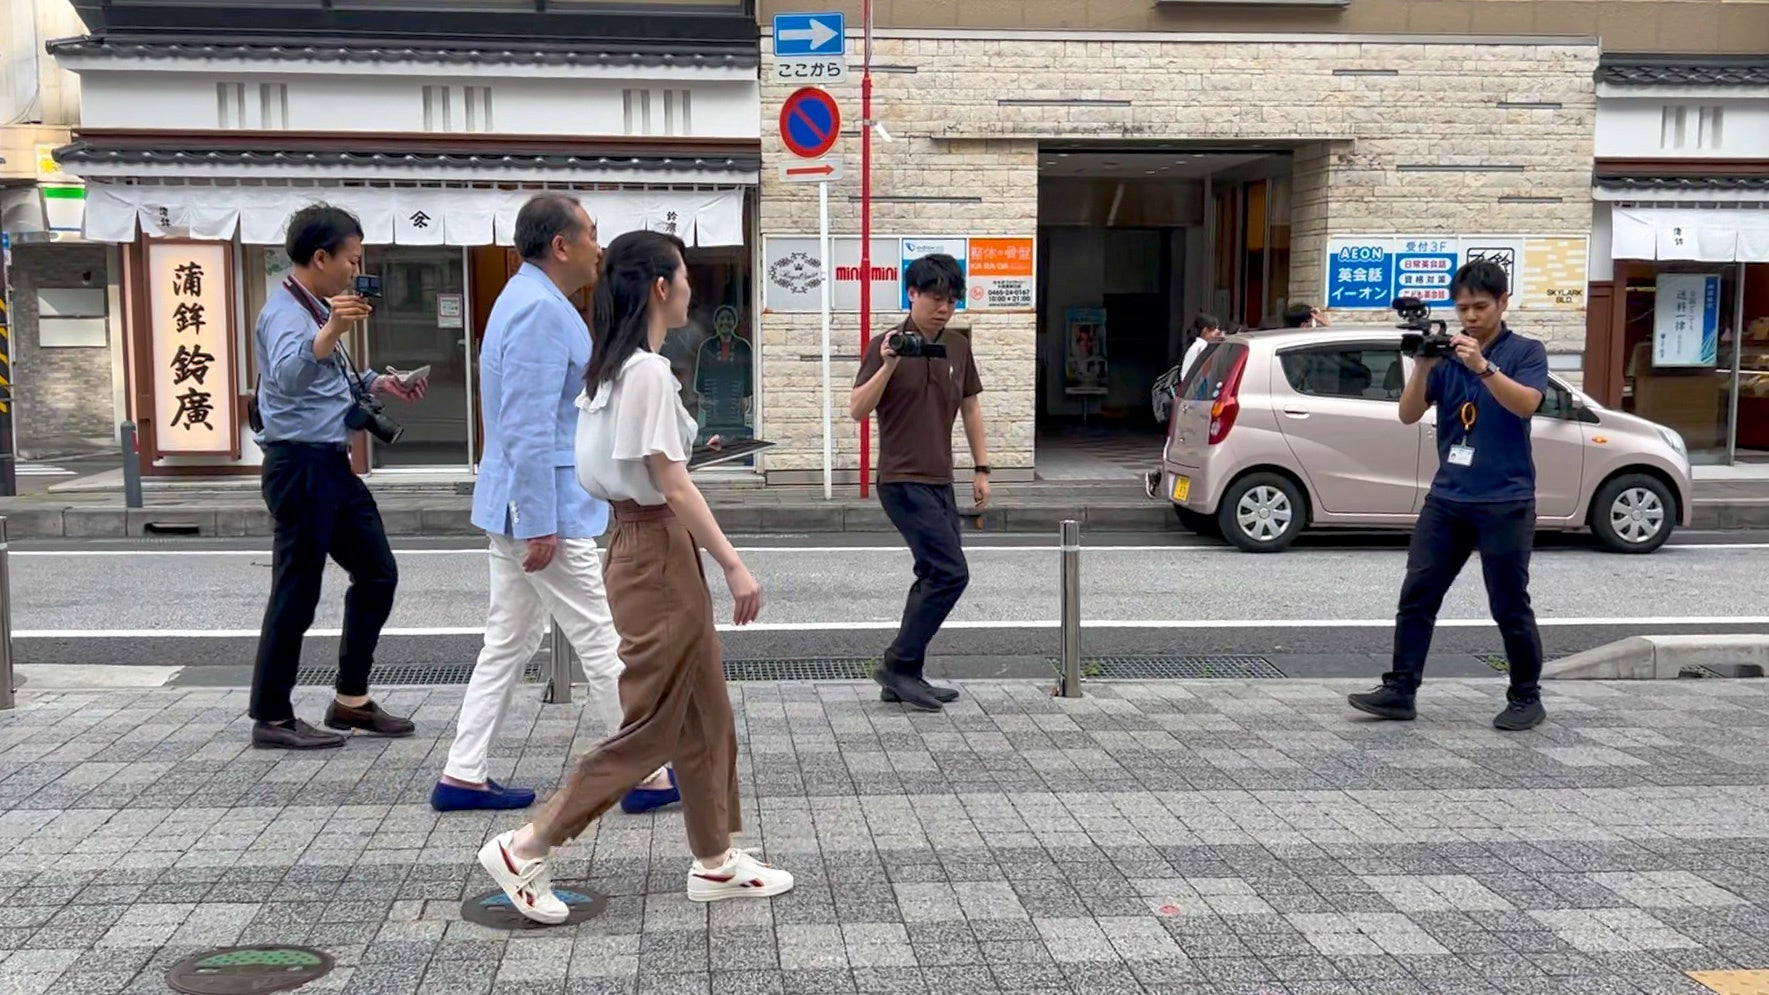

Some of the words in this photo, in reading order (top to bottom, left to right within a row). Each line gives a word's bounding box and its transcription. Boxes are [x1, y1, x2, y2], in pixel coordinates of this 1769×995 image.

[778, 62, 841, 77] ここから
[1339, 247, 1383, 261] AEON
[1404, 260, 1447, 270] 日常英会話
[871, 267, 897, 280] mini
[1338, 268, 1383, 282] 英会話
[1332, 286, 1388, 300] イーオン
